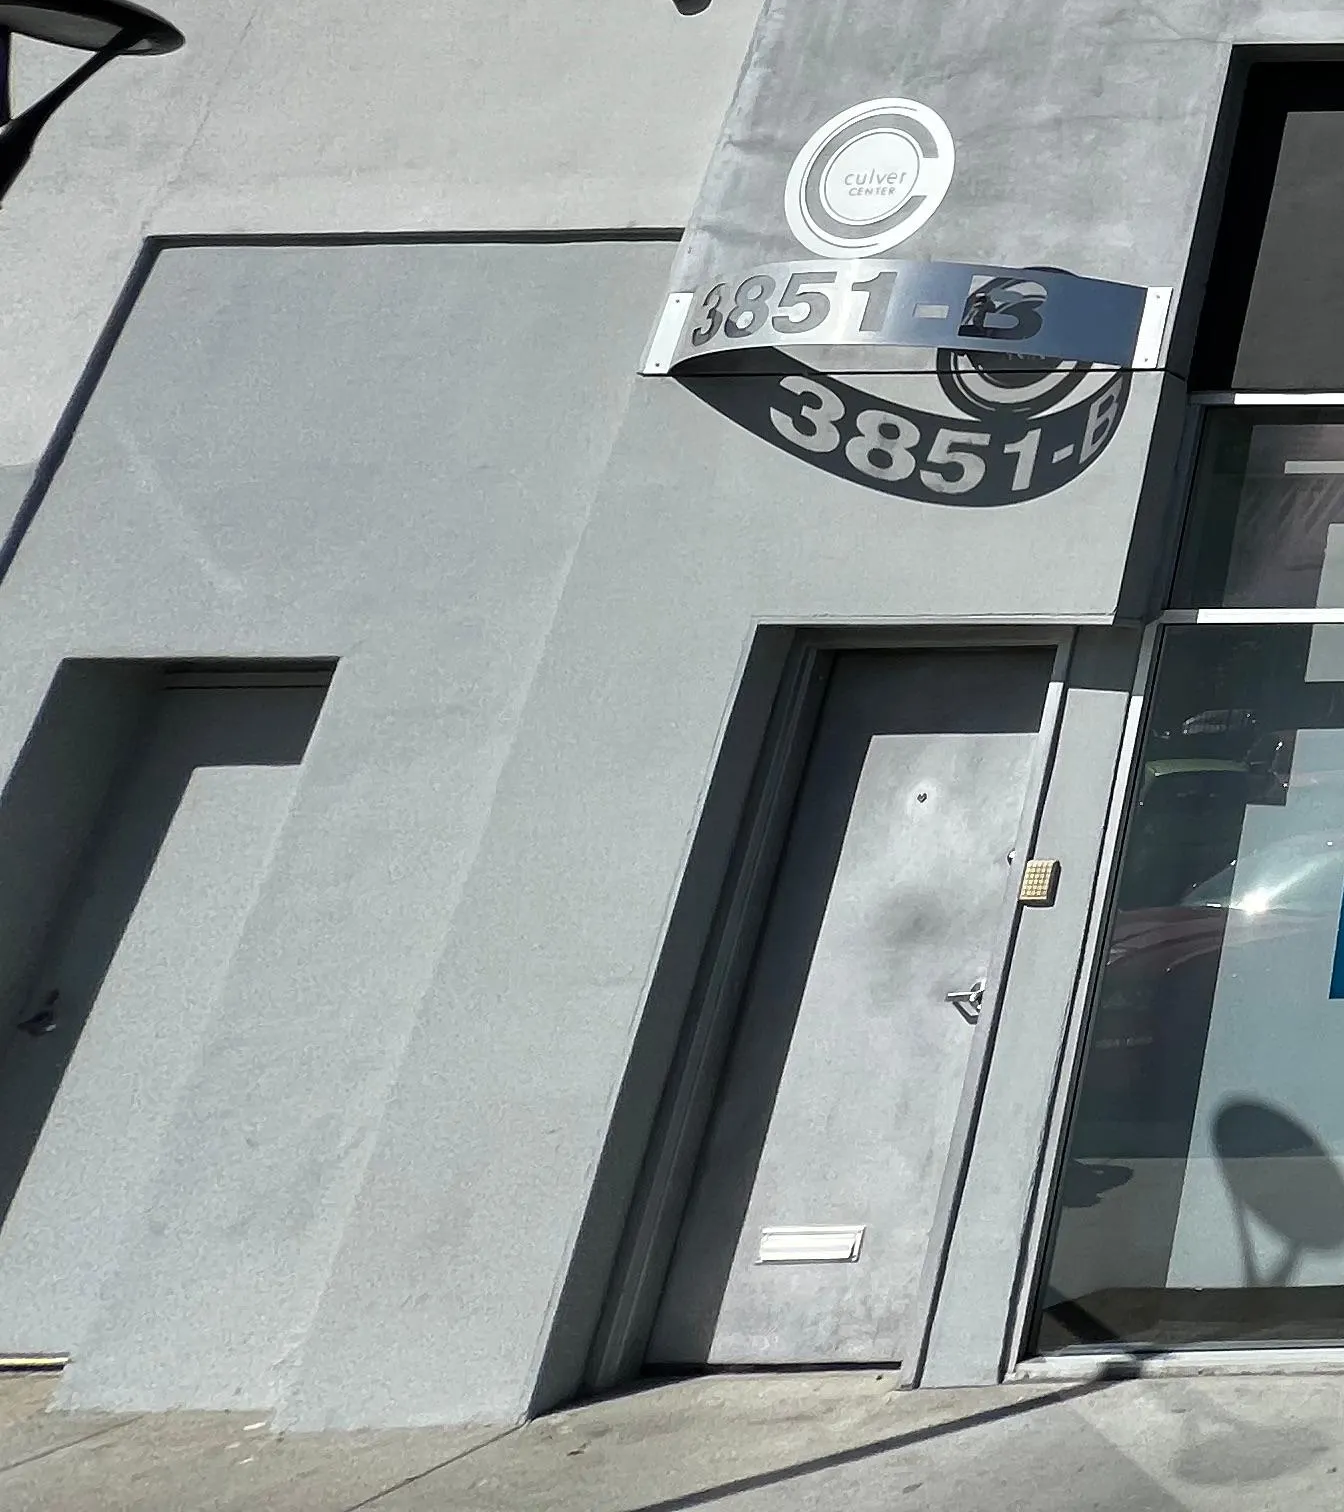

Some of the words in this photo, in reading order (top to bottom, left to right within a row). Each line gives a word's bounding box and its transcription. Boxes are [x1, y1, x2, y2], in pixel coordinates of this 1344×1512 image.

[844, 168, 907, 186] culver
[848, 187, 896, 196] CENTER
[691, 270, 1048, 346] 3851-B
